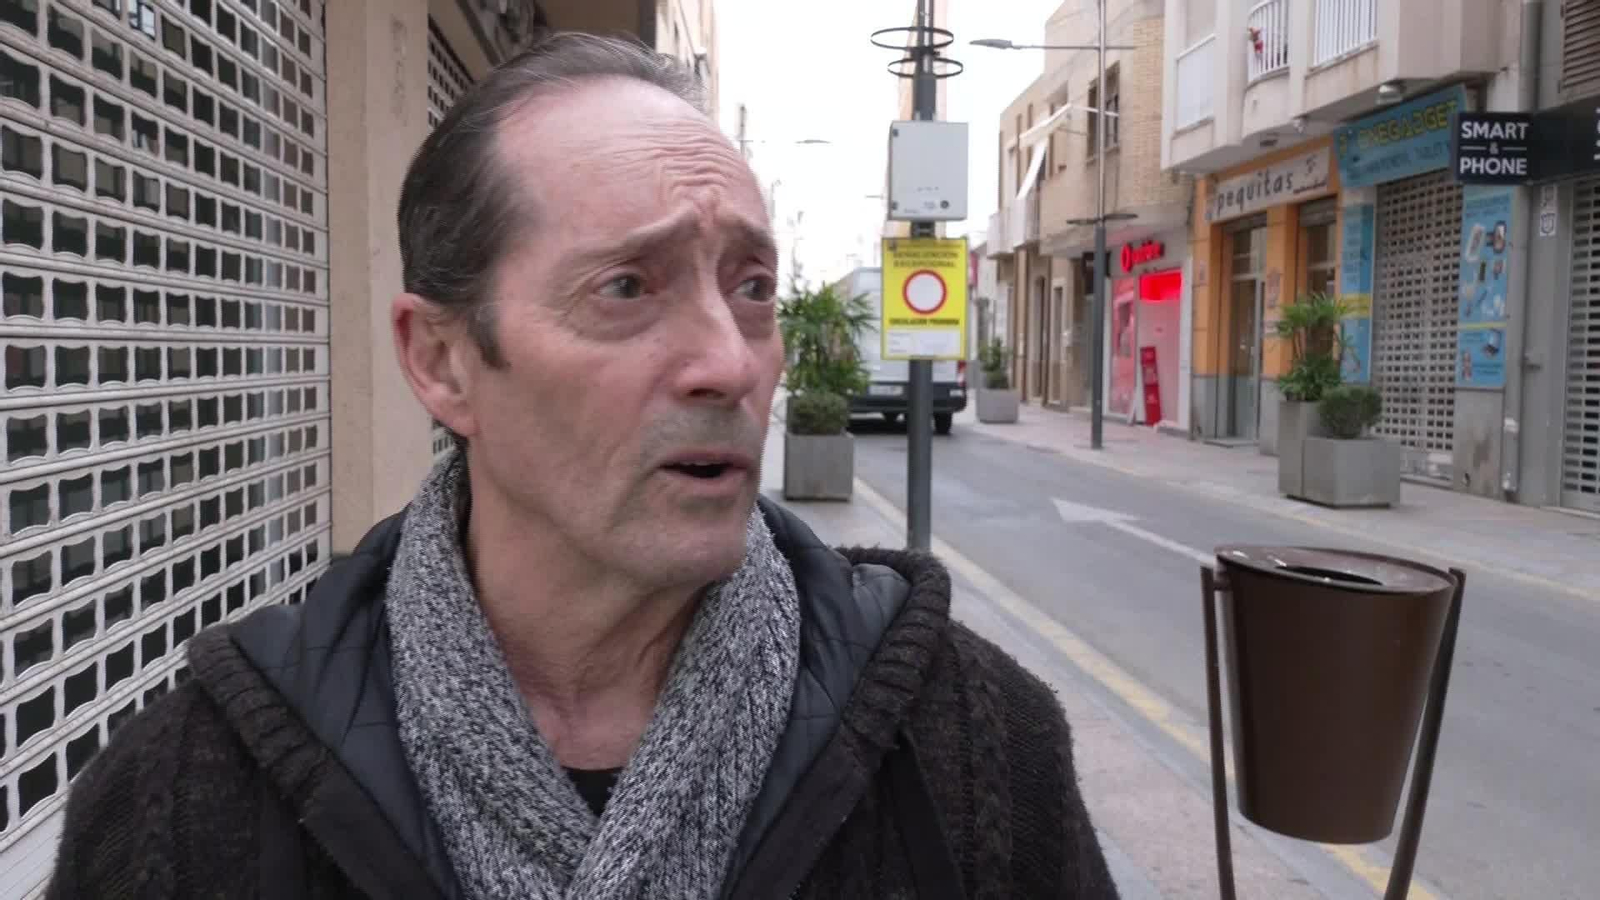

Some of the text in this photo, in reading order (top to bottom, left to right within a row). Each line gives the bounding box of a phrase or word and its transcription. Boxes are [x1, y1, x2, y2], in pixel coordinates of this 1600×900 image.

[1459, 121, 1529, 141] SMART
[1489, 142, 1499, 154] &
[1459, 156, 1528, 175] PHONE
[1217, 170, 1294, 216] pequitas
